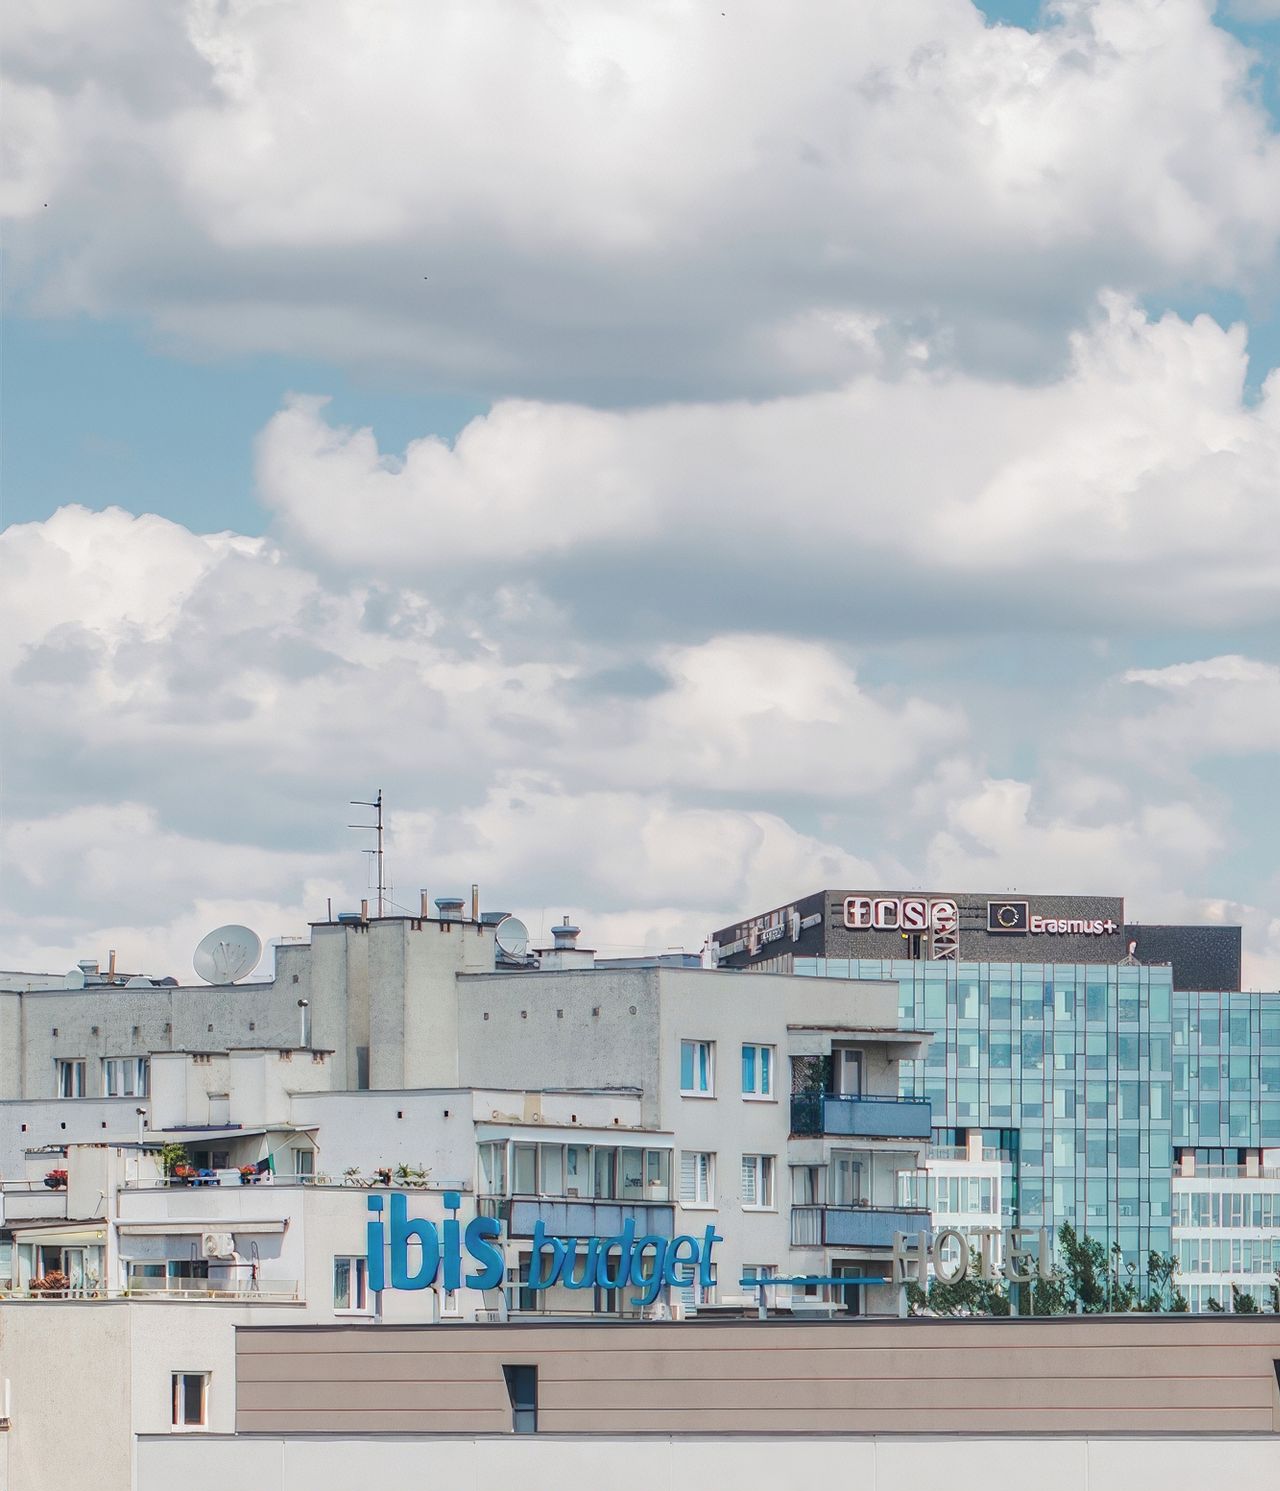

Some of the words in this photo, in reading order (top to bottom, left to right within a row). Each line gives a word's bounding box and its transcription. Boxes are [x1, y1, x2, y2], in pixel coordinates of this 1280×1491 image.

[1030, 916, 1117, 934] Erasmus+
[367, 1191, 505, 1292] ibis
[527, 1217, 724, 1306] budget
[893, 1228, 1065, 1285] HOTEL
